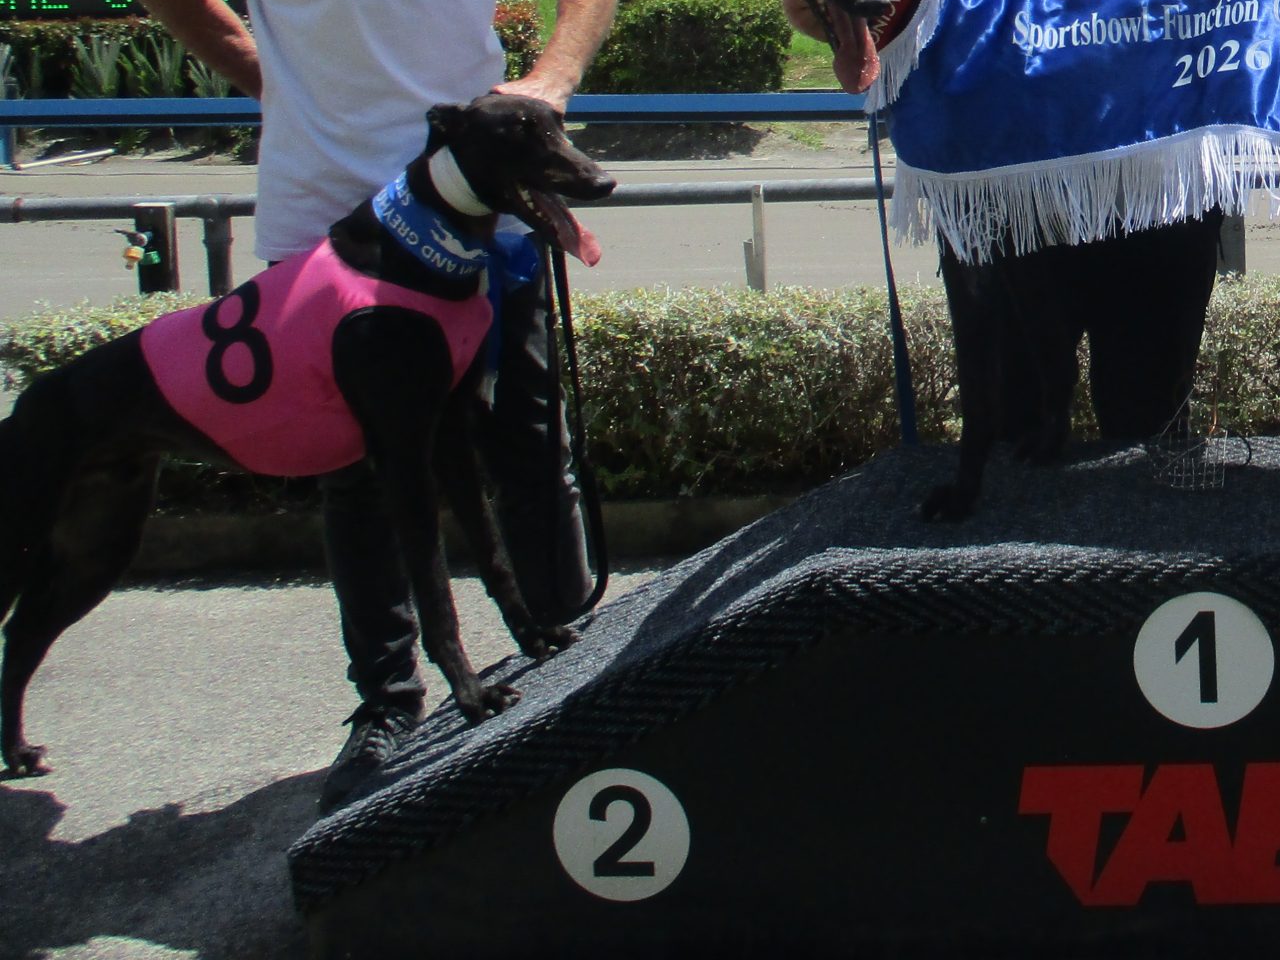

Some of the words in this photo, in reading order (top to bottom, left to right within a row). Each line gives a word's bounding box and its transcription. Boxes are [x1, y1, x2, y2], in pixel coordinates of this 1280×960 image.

[1012, 5, 1151, 57] Sportsbowl
[1171, 39, 1271, 89] 2026
[202, 280, 273, 404] 8
[1174, 611, 1218, 704] 1
[589, 784, 656, 877] 2
